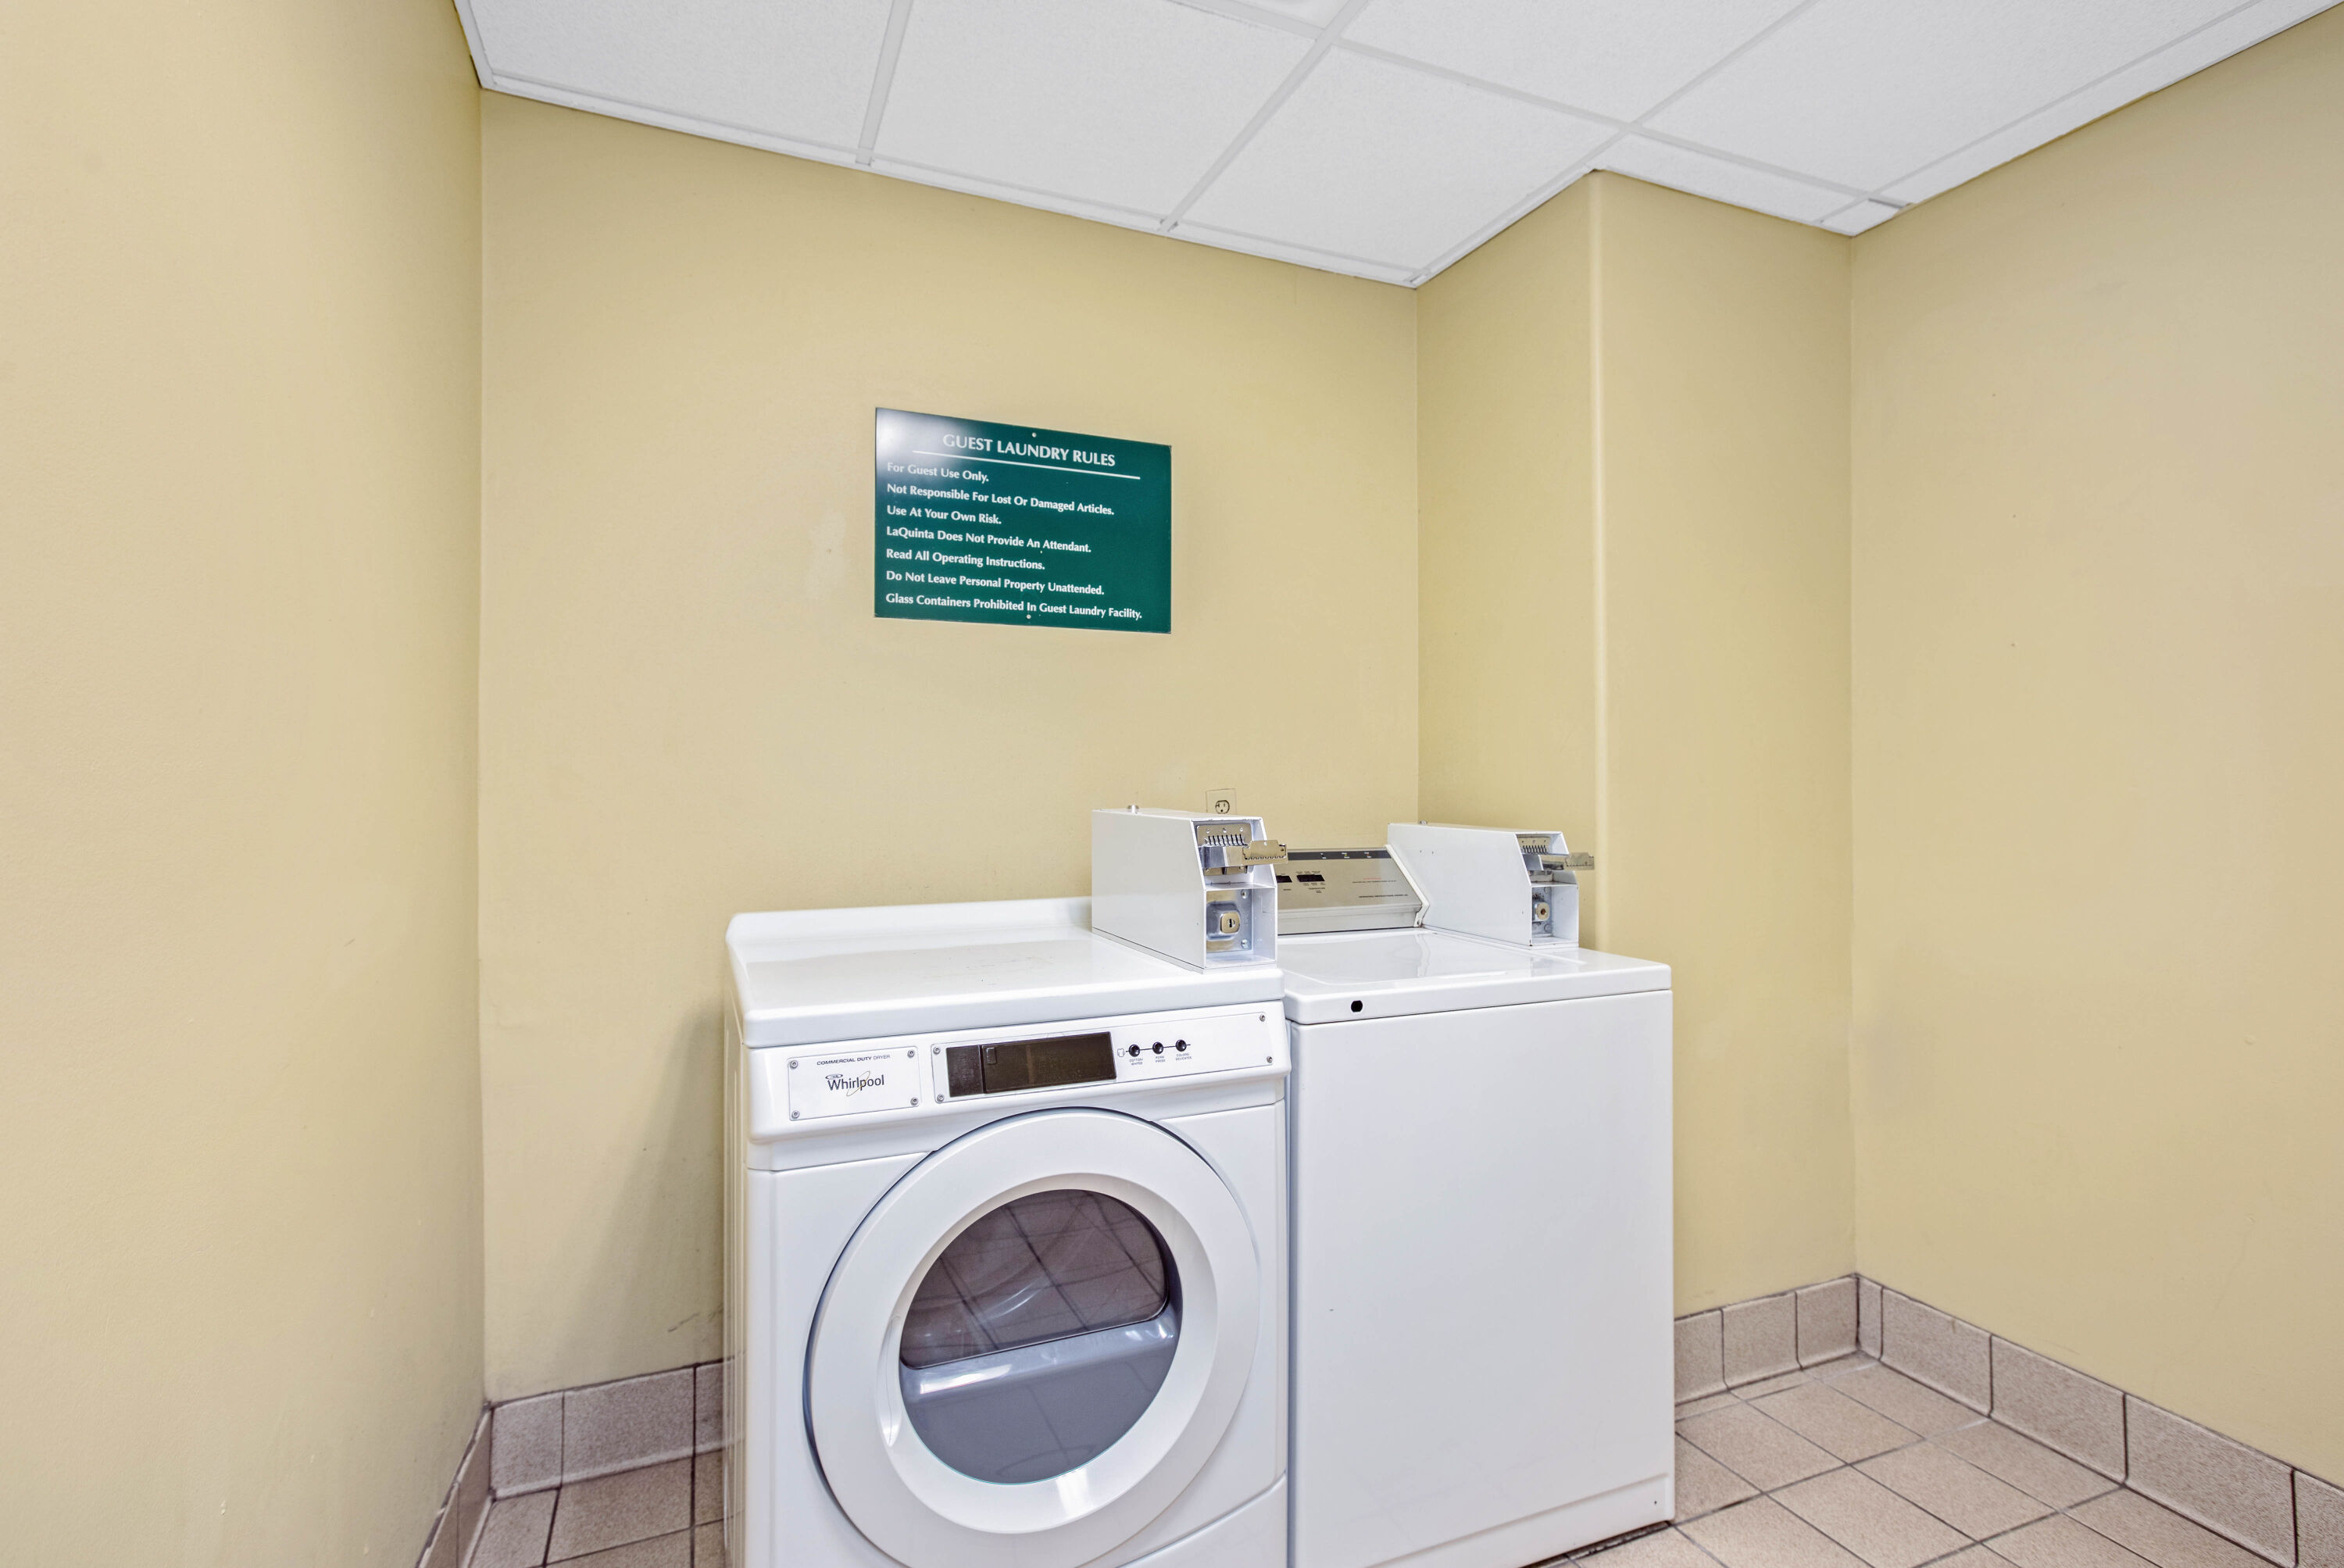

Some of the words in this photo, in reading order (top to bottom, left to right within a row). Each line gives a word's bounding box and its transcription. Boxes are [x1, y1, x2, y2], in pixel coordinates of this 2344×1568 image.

[942, 434, 994, 452] GUEST
[997, 440, 1070, 461] LAUNDRY
[1073, 449, 1116, 467] RULES
[887, 462, 905, 473] For
[907, 464, 938, 477] Guest
[941, 468, 960, 479] Use
[962, 470, 989, 484] Only.
[887, 483, 907, 495] Not
[909, 485, 970, 501] Responsible
[972, 491, 989, 502] For
[992, 493, 1012, 505] Lost
[1013, 495, 1028, 506] Or
[1030, 497, 1075, 513] Damaged
[1077, 502, 1115, 516] Articles.
[887, 505, 907, 516] Use
[909, 507, 922, 517] At
[924, 508, 949, 520] Your
[950, 510, 977, 523] Own
[978, 513, 1002, 525] Risk.
[886, 526, 934, 539] LaQuinta
[937, 530, 963, 542] Does
[966, 532, 985, 544] Not
[987, 534, 1024, 547] Provide
[1026, 538, 1041, 548] An
[1042, 539, 1092, 553] Attendant.
[886, 548, 913, 560] Read
[914, 550, 930, 561] All
[932, 552, 984, 568] Operating
[985, 555, 1045, 570] Instructions.
[886, 570, 902, 581] Do
[905, 571, 925, 583] Not
[927, 573, 957, 584] Leave
[959, 575, 1002, 588] Personal
[1003, 578, 1045, 594] Property
[1048, 581, 1105, 595] Unattended.
[885, 592, 914, 604] Glass
[916, 595, 971, 608] Containers
[974, 598, 1024, 611] Prohibited
[1027, 602, 1037, 612] In
[1038, 602, 1067, 614] Guest
[1069, 605, 1106, 619] Laundry
[1108, 607, 1142, 620] Facility.
[827, 1074, 884, 1091] Whirlpool
